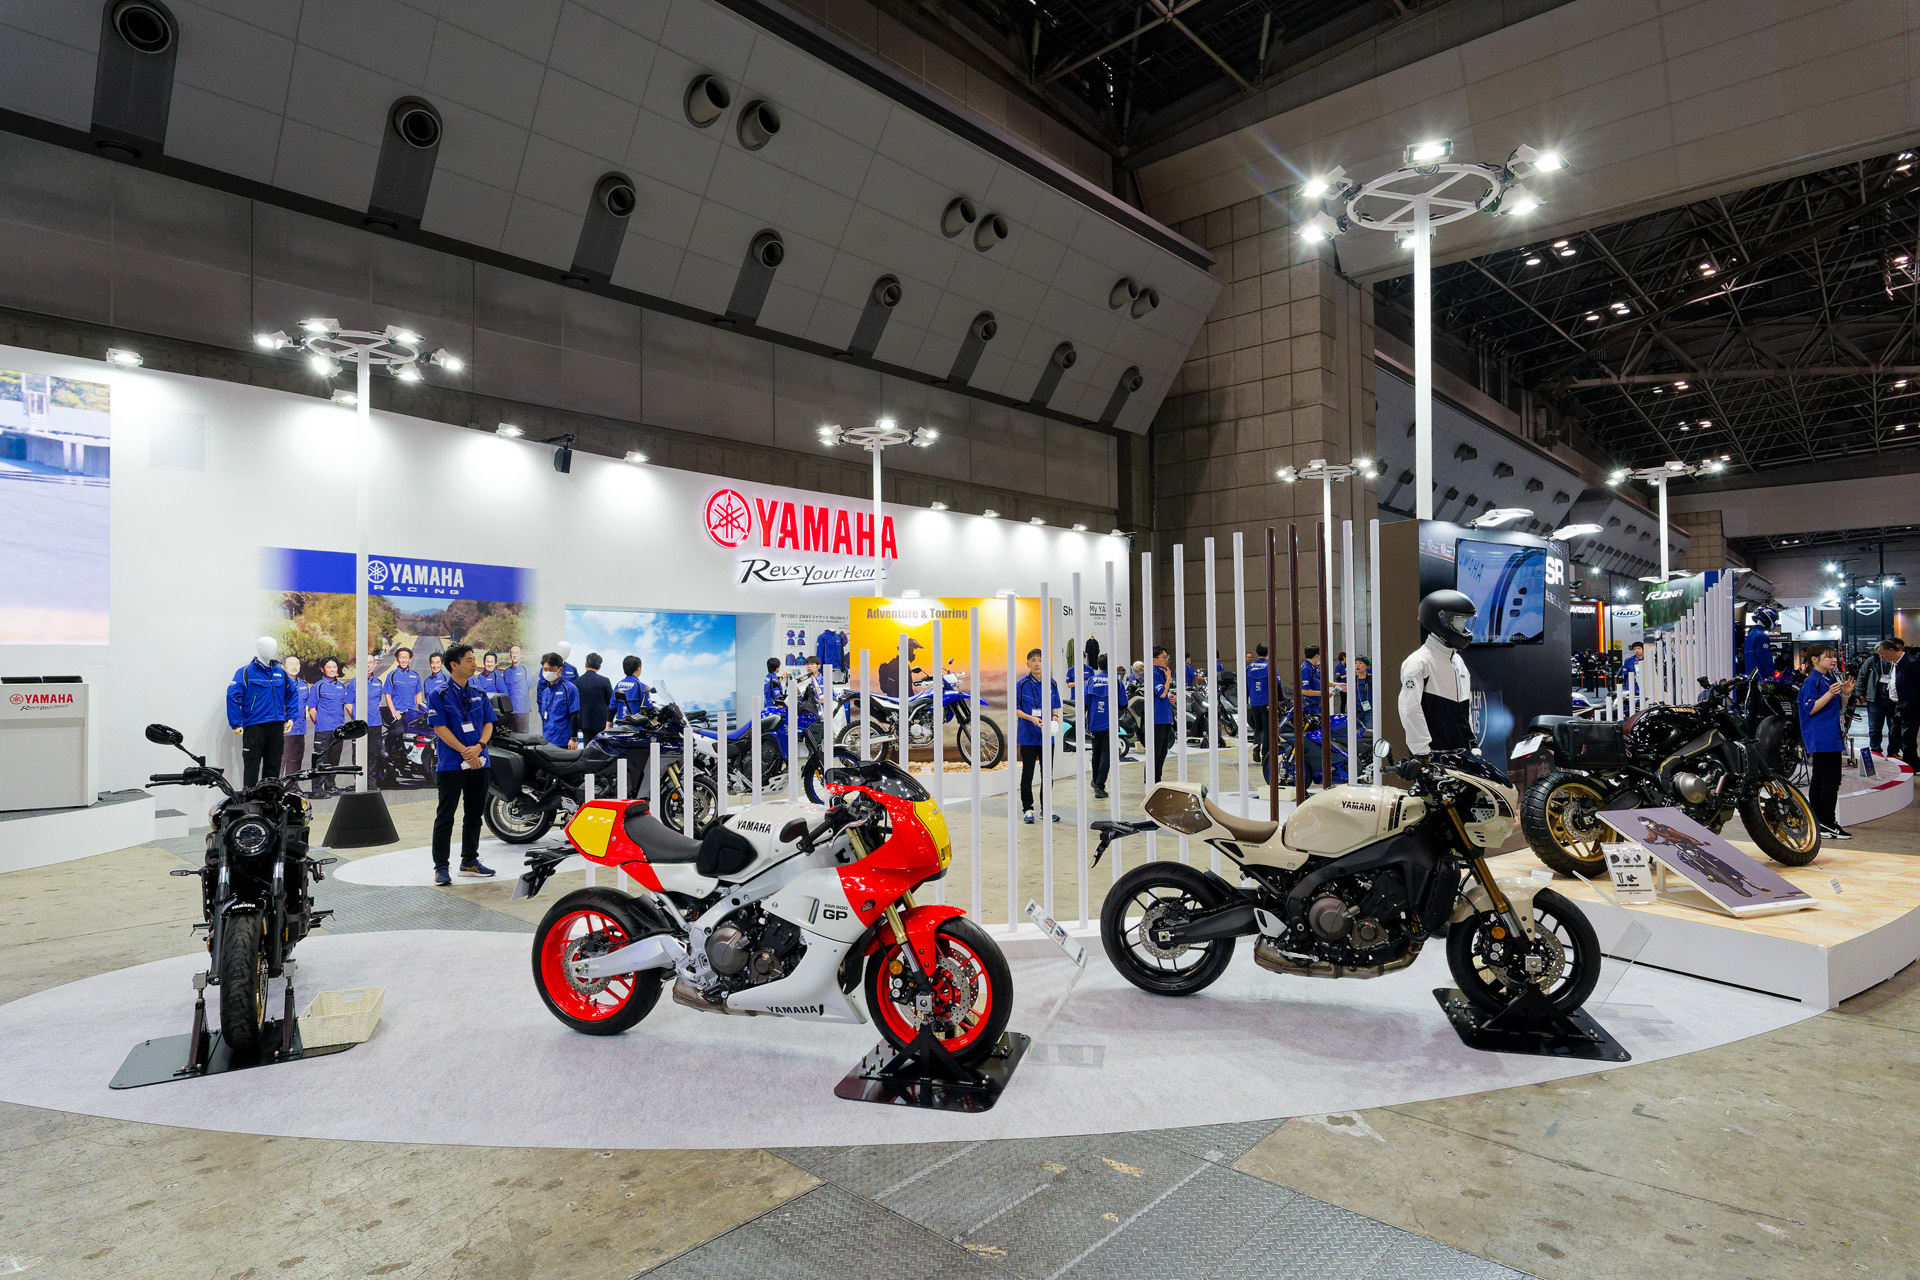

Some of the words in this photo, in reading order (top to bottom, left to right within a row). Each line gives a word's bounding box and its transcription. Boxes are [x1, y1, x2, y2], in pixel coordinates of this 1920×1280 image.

[754, 497, 898, 560] YAMAHA
[389, 562, 464, 588] YAMAHA
[738, 558, 802, 584] Revs
[801, 565, 844, 586] Your
[843, 564, 885, 580] Hear
[373, 584, 460, 595] RACING
[866, 608, 919, 619] Adventure
[921, 610, 928, 619] &
[930, 608, 968, 620] Touring
[24, 693, 74, 704] YAMAHA
[1341, 800, 1376, 813] YAMAHA
[736, 820, 772, 834] YAMAHA
[823, 909, 848, 921] GP
[766, 1005, 818, 1014] YAMAHA
